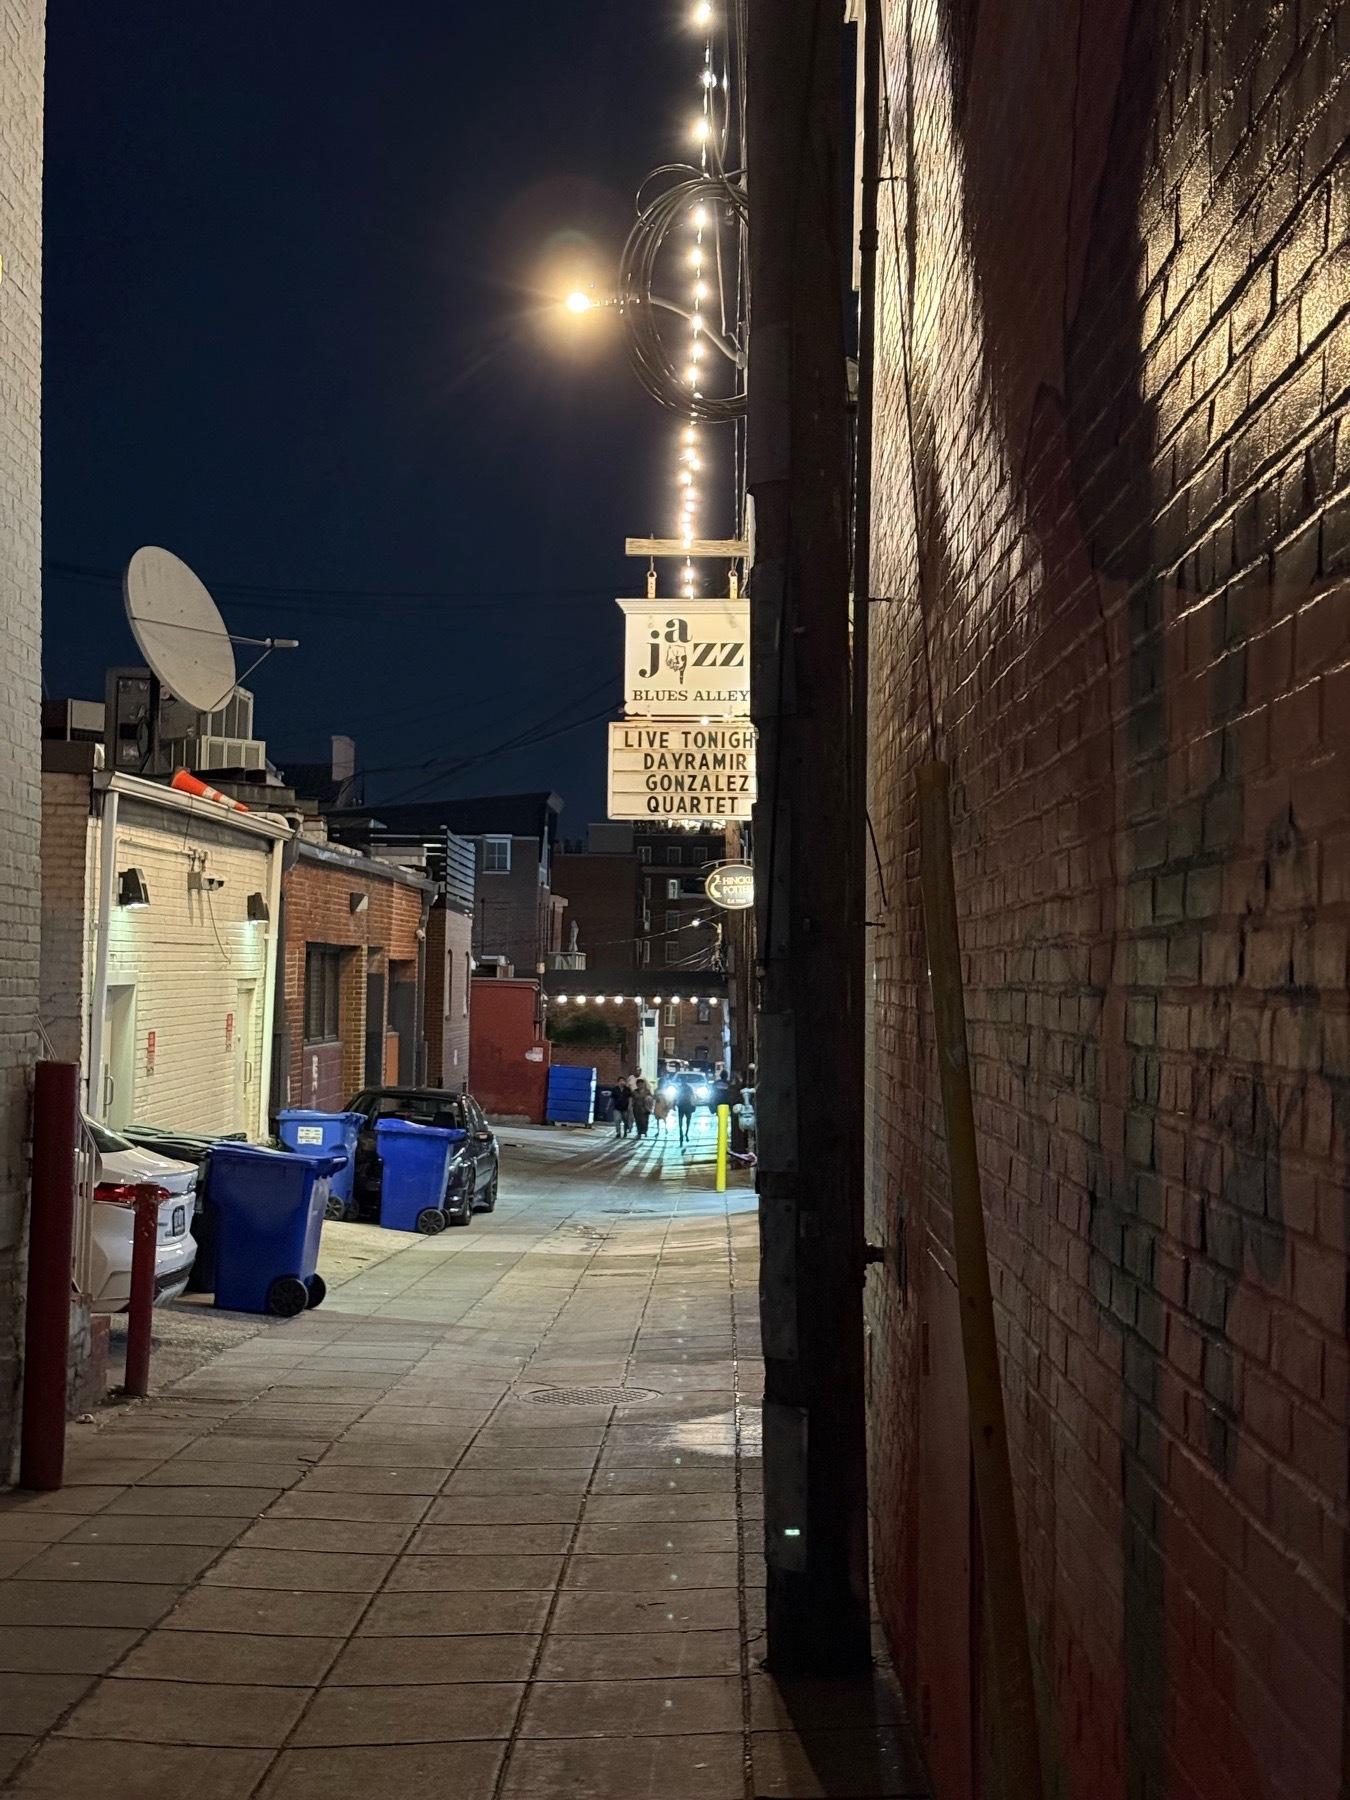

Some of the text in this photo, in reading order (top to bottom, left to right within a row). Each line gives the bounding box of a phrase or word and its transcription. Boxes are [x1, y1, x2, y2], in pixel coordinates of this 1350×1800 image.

[639, 618, 744, 678] jazz
[632, 690, 750, 701] BLUES ALLEY
[624, 731, 669, 748] LIVE
[643, 753, 747, 770] DAYRAMIR
[645, 774, 749, 792] GONZALEZ
[647, 796, 738, 813] QUARTET
